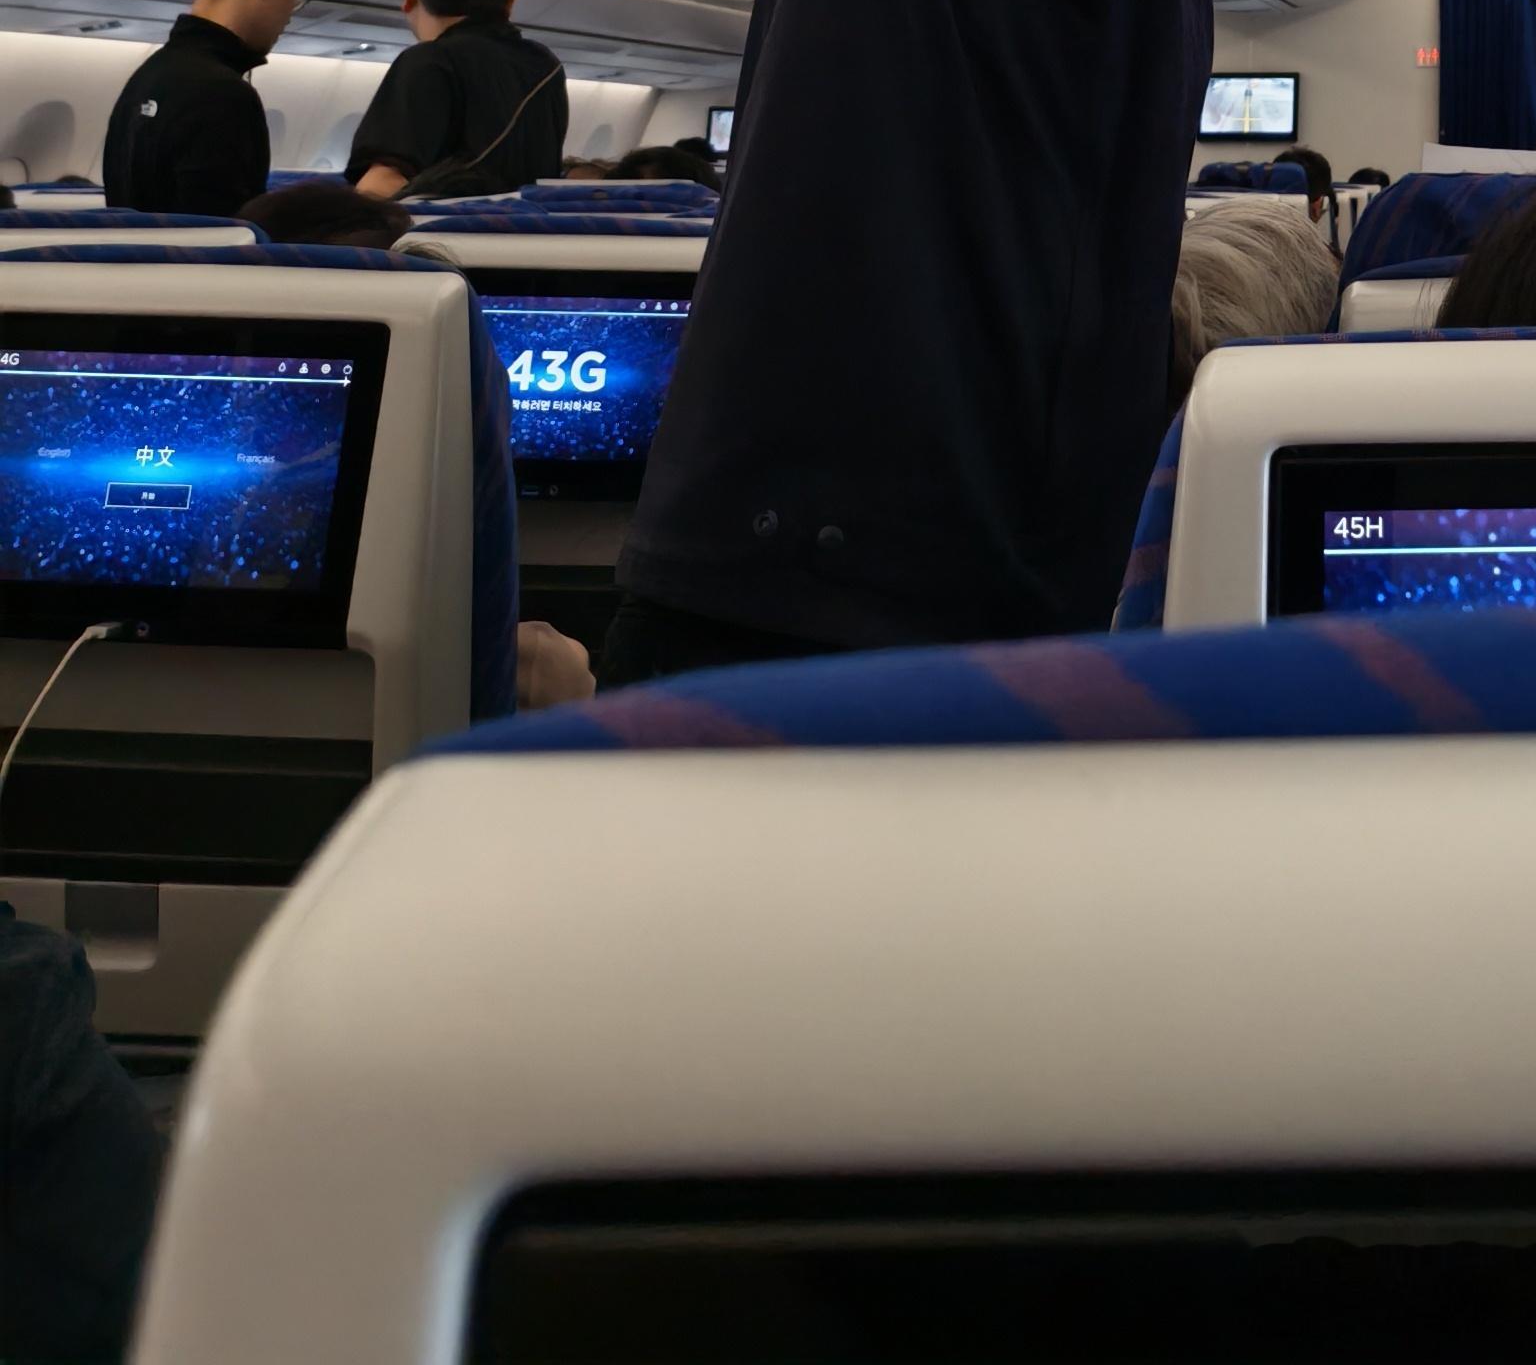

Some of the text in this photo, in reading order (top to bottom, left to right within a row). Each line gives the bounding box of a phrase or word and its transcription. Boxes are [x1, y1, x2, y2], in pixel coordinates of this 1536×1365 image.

[507, 349, 607, 392] 43G
[135, 444, 176, 467] 中文
[1333, 516, 1384, 539] 45H
